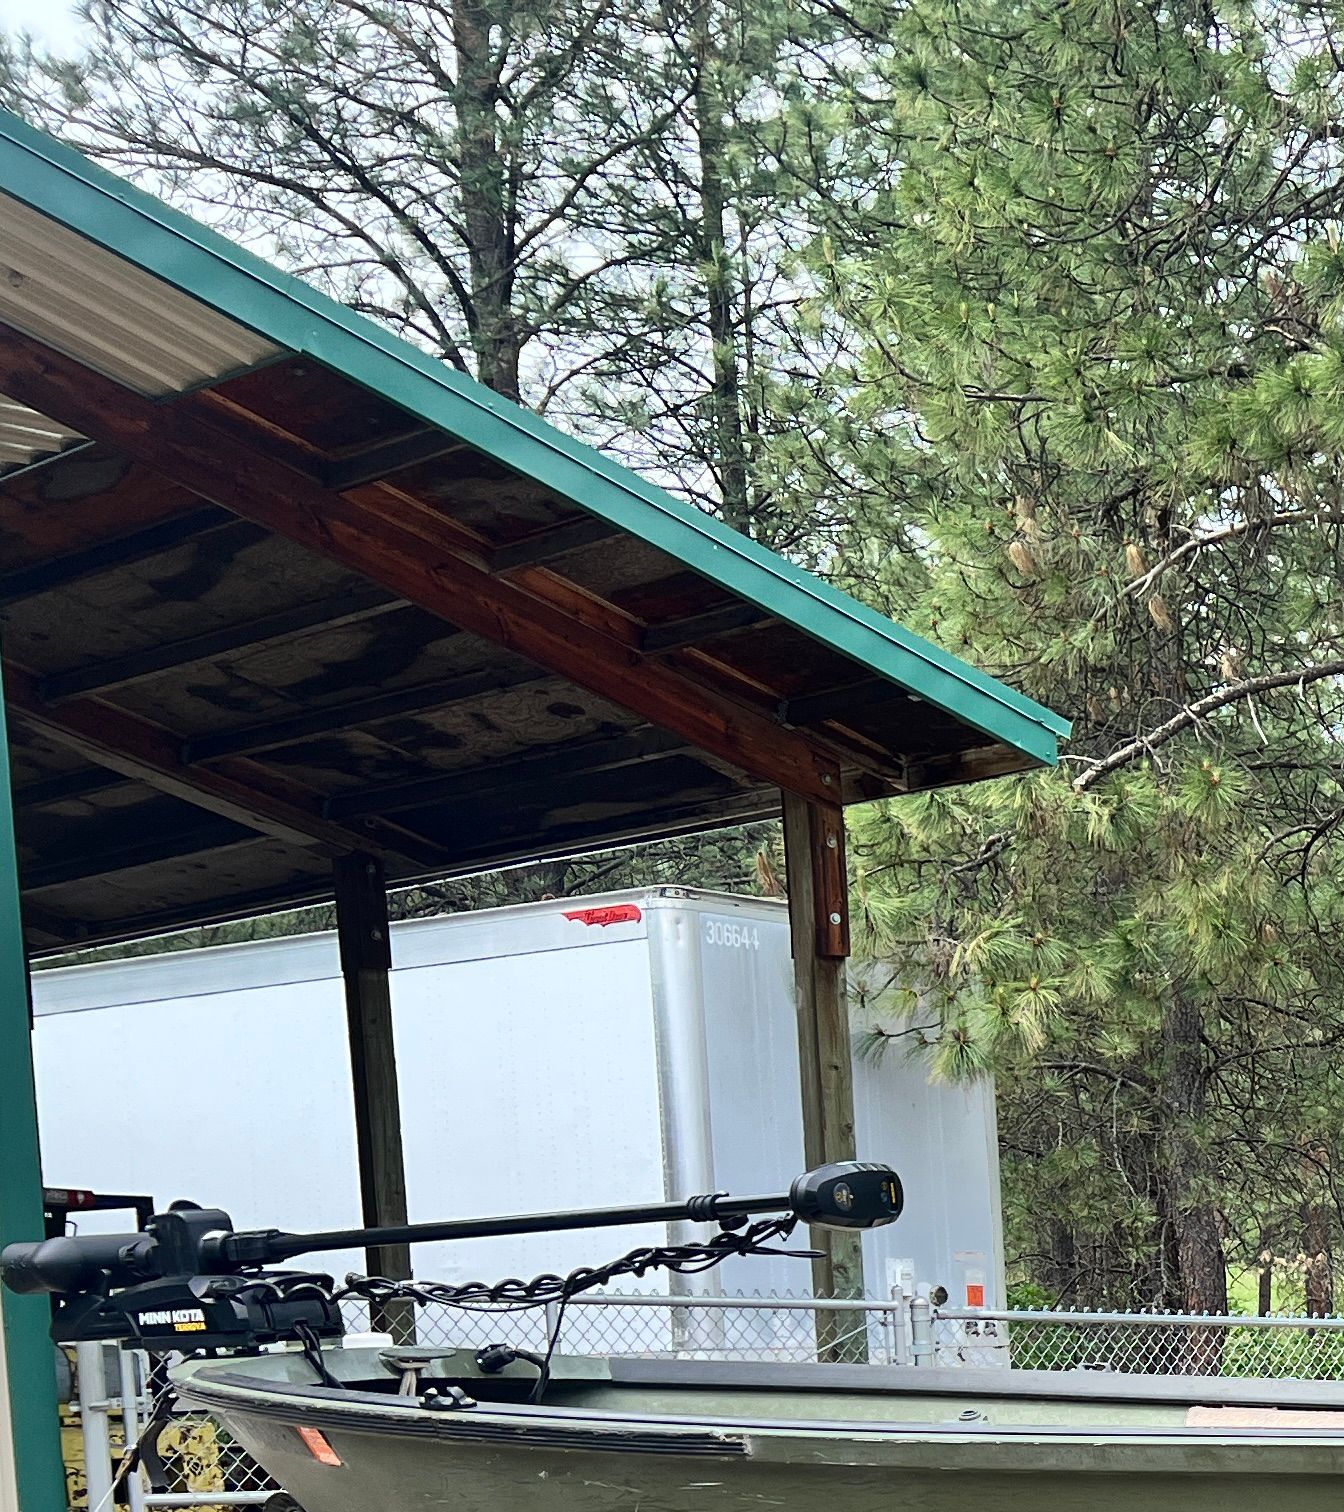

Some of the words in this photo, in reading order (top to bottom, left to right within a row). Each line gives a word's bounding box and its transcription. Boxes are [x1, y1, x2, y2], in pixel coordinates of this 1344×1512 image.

[705, 921, 760, 950] 306644
[138, 1310, 171, 1325] MINN
[172, 1308, 205, 1323] KOTA
